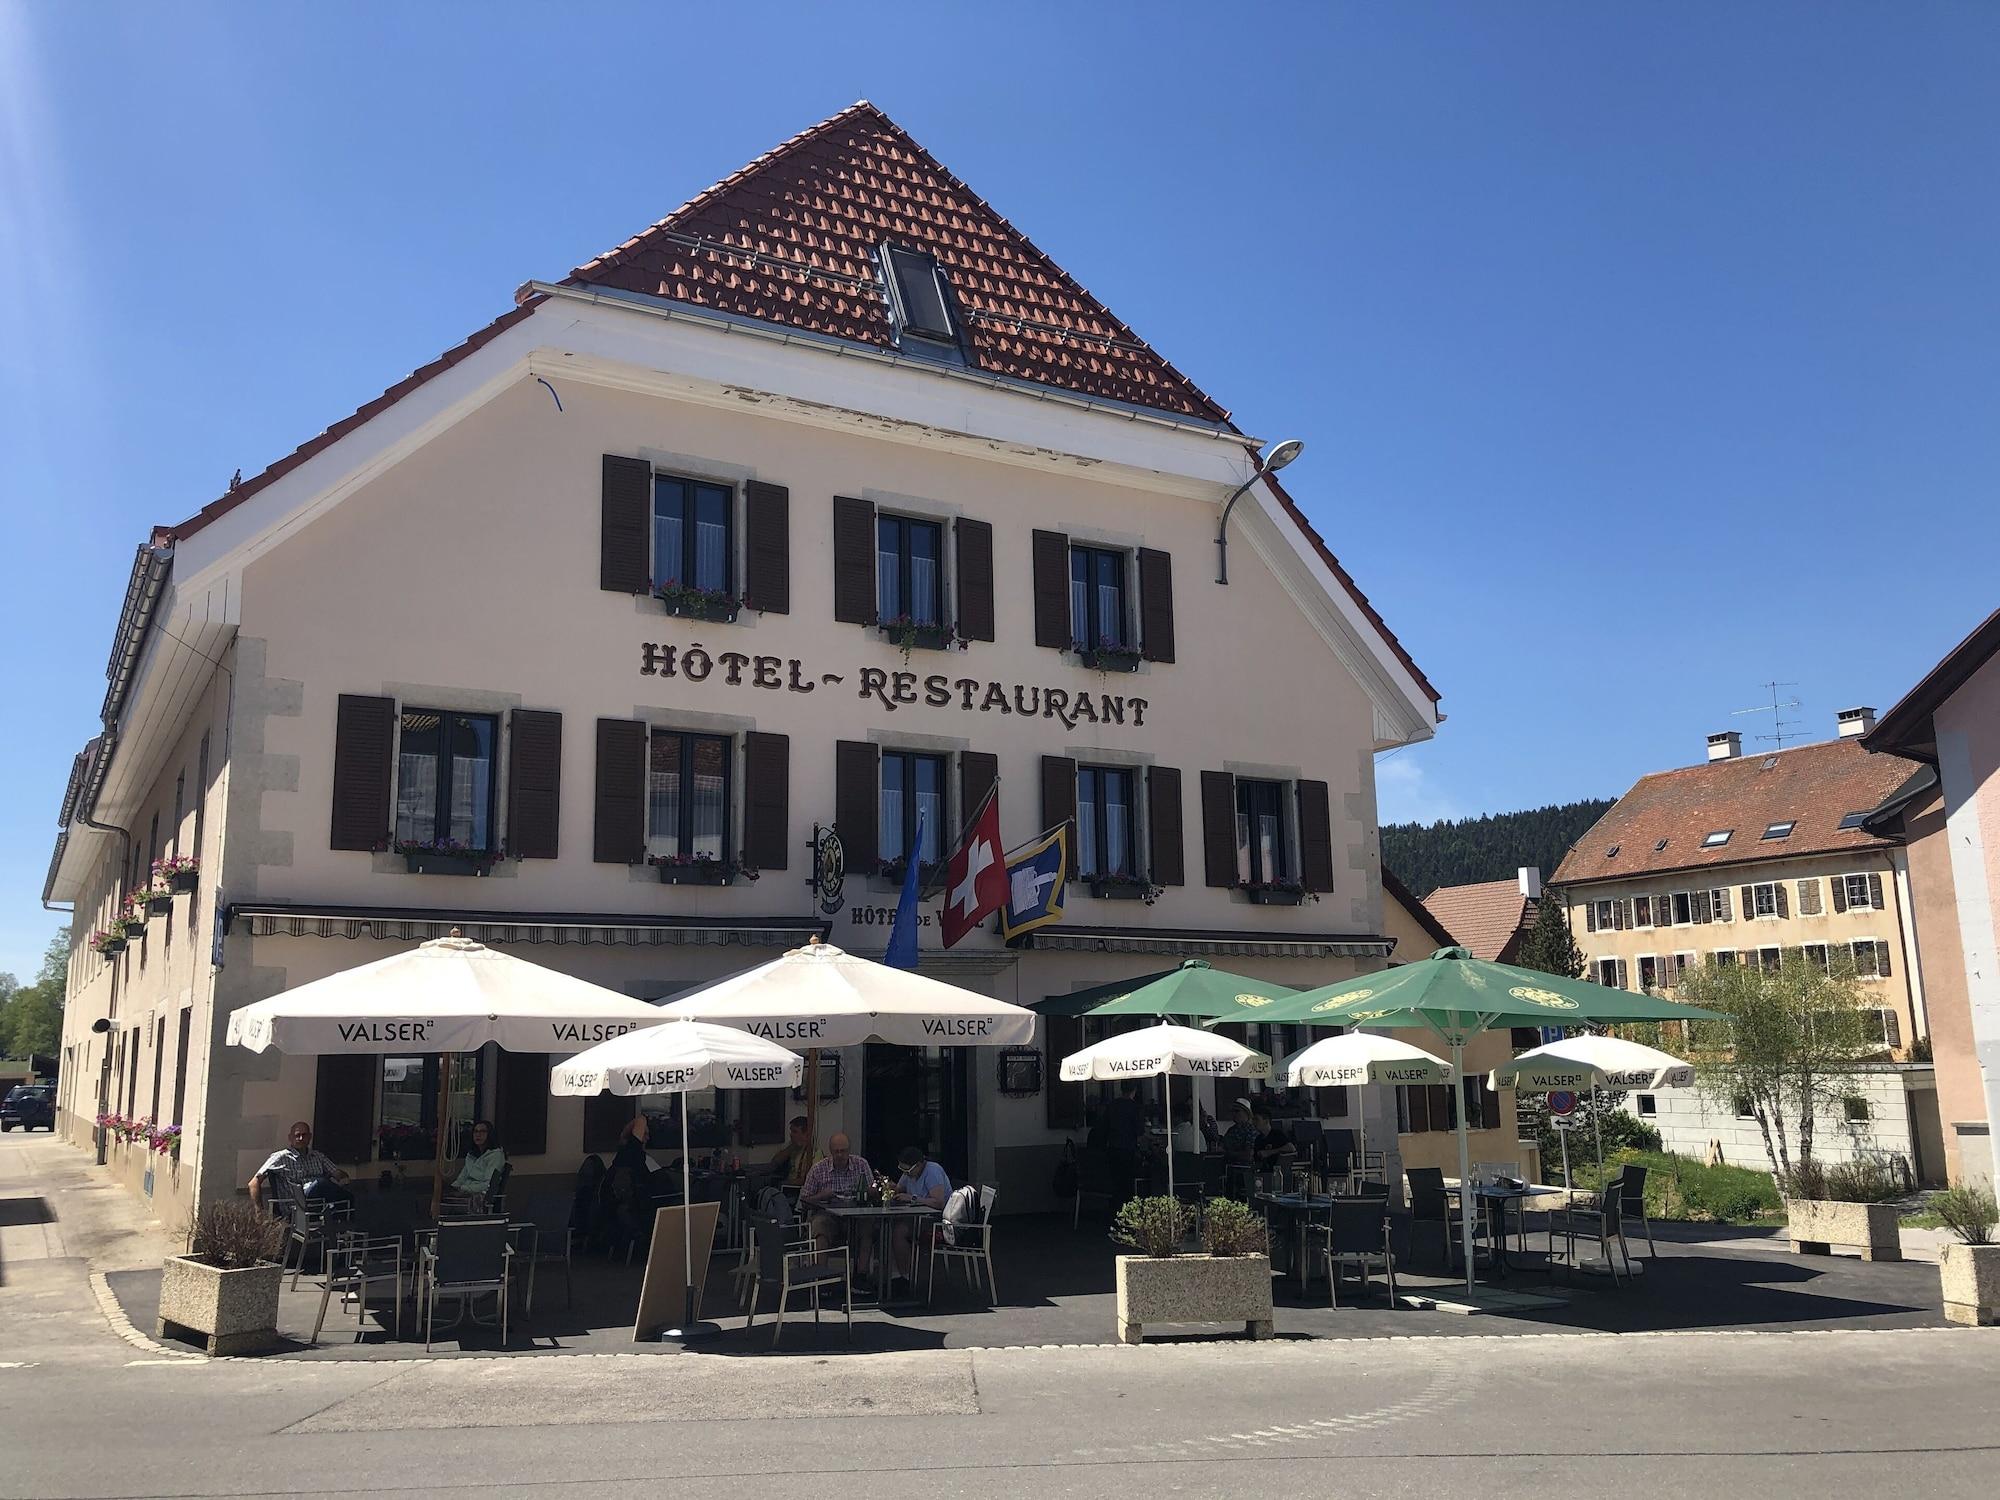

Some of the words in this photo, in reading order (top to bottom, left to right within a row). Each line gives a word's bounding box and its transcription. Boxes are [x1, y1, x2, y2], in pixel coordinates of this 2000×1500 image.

[859, 667, 1148, 731] RESTAURANT
[851, 905, 897, 926] HÔTE
[338, 1023, 426, 1041] VALSER
[747, 1021, 821, 1039] VALSER
[922, 1019, 988, 1036] VALSER
[1109, 1060, 1154, 1072] VALSER
[1188, 1060, 1233, 1072] VALSER
[626, 1070, 685, 1087] VALSER
[727, 1067, 776, 1081] VALSER
[1315, 1069, 1357, 1080] VALSER
[1385, 1069, 1424, 1080] VALSER
[1532, 1076, 1574, 1086] VALSER
[1605, 1074, 1648, 1085] VALSER
